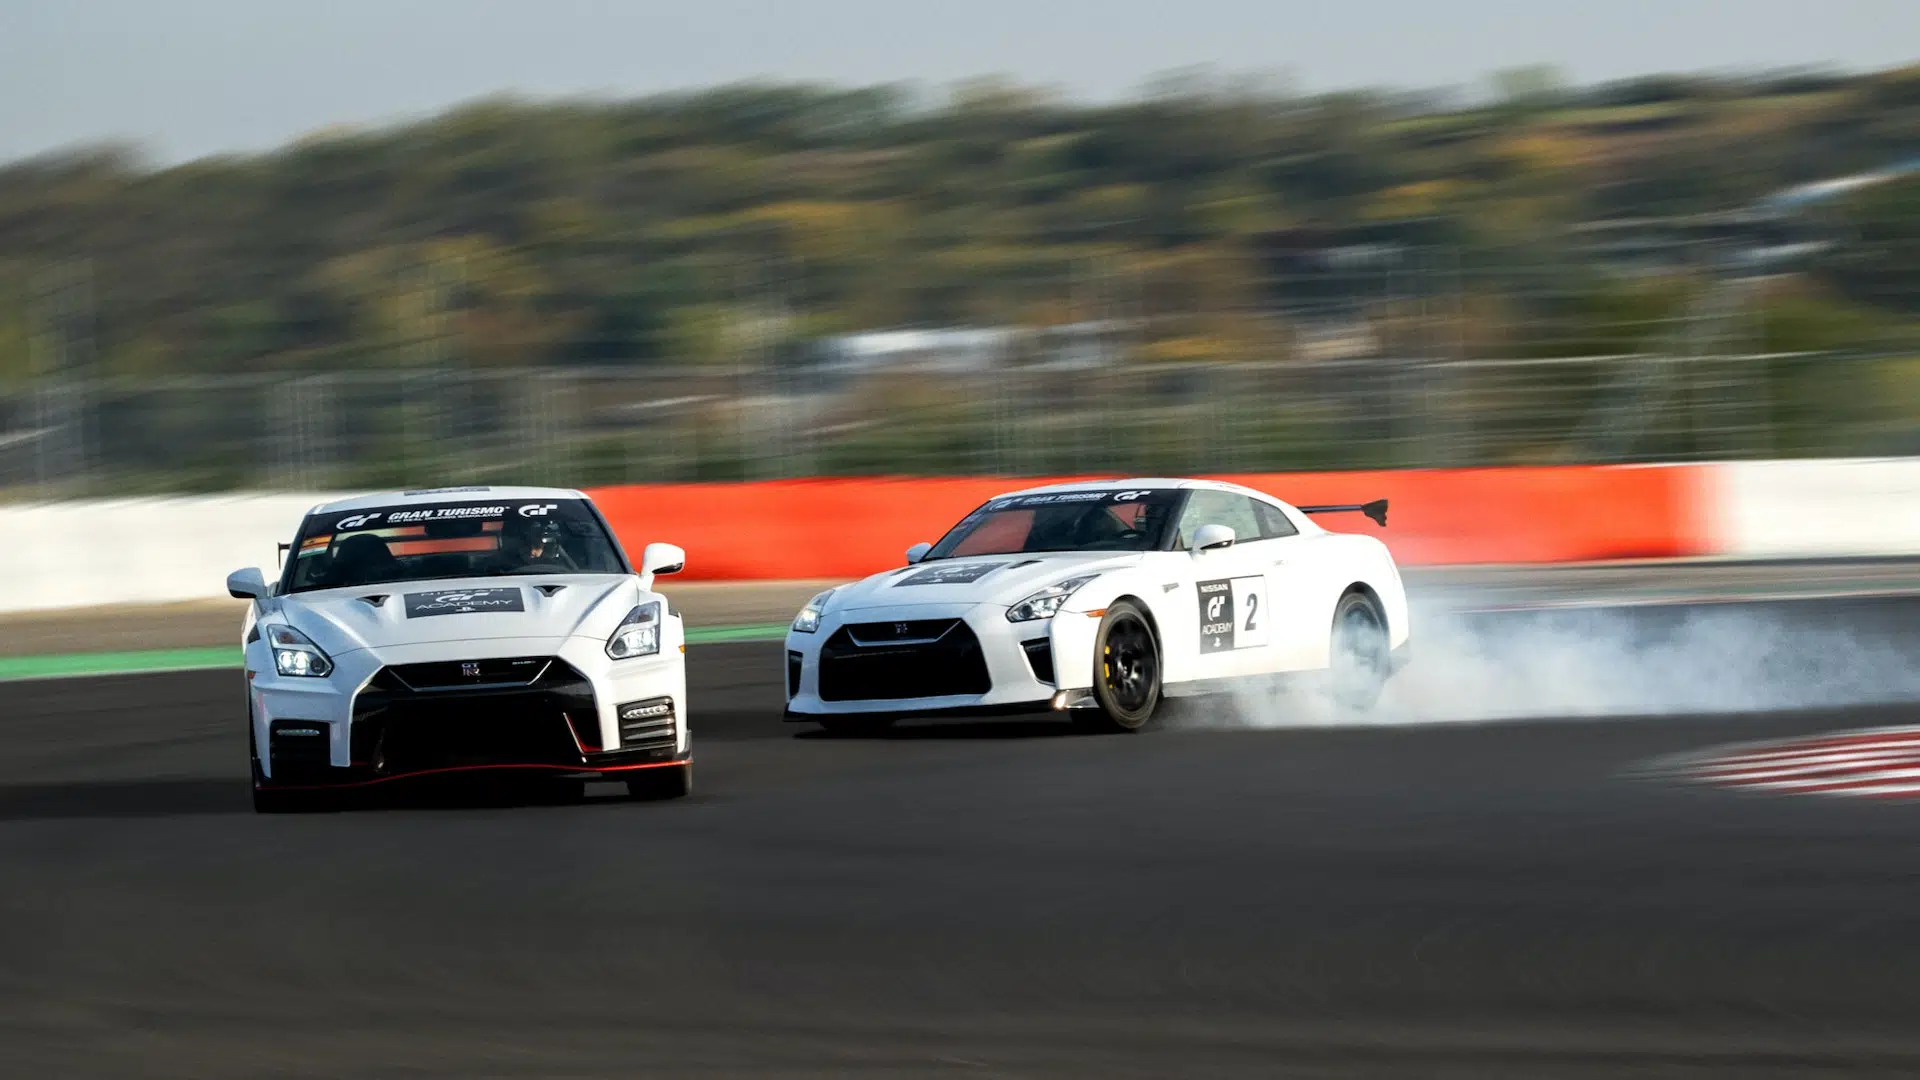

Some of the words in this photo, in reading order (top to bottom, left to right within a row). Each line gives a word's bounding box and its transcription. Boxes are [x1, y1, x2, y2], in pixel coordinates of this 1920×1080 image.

[388, 510, 433, 520] GRAN
[437, 506, 504, 517] TURISMO
[1201, 583, 1228, 593] NISSAN
[416, 600, 512, 611] ACADEMY
[1245, 593, 1258, 631] 2
[1202, 622, 1233, 635] ACADEMY
